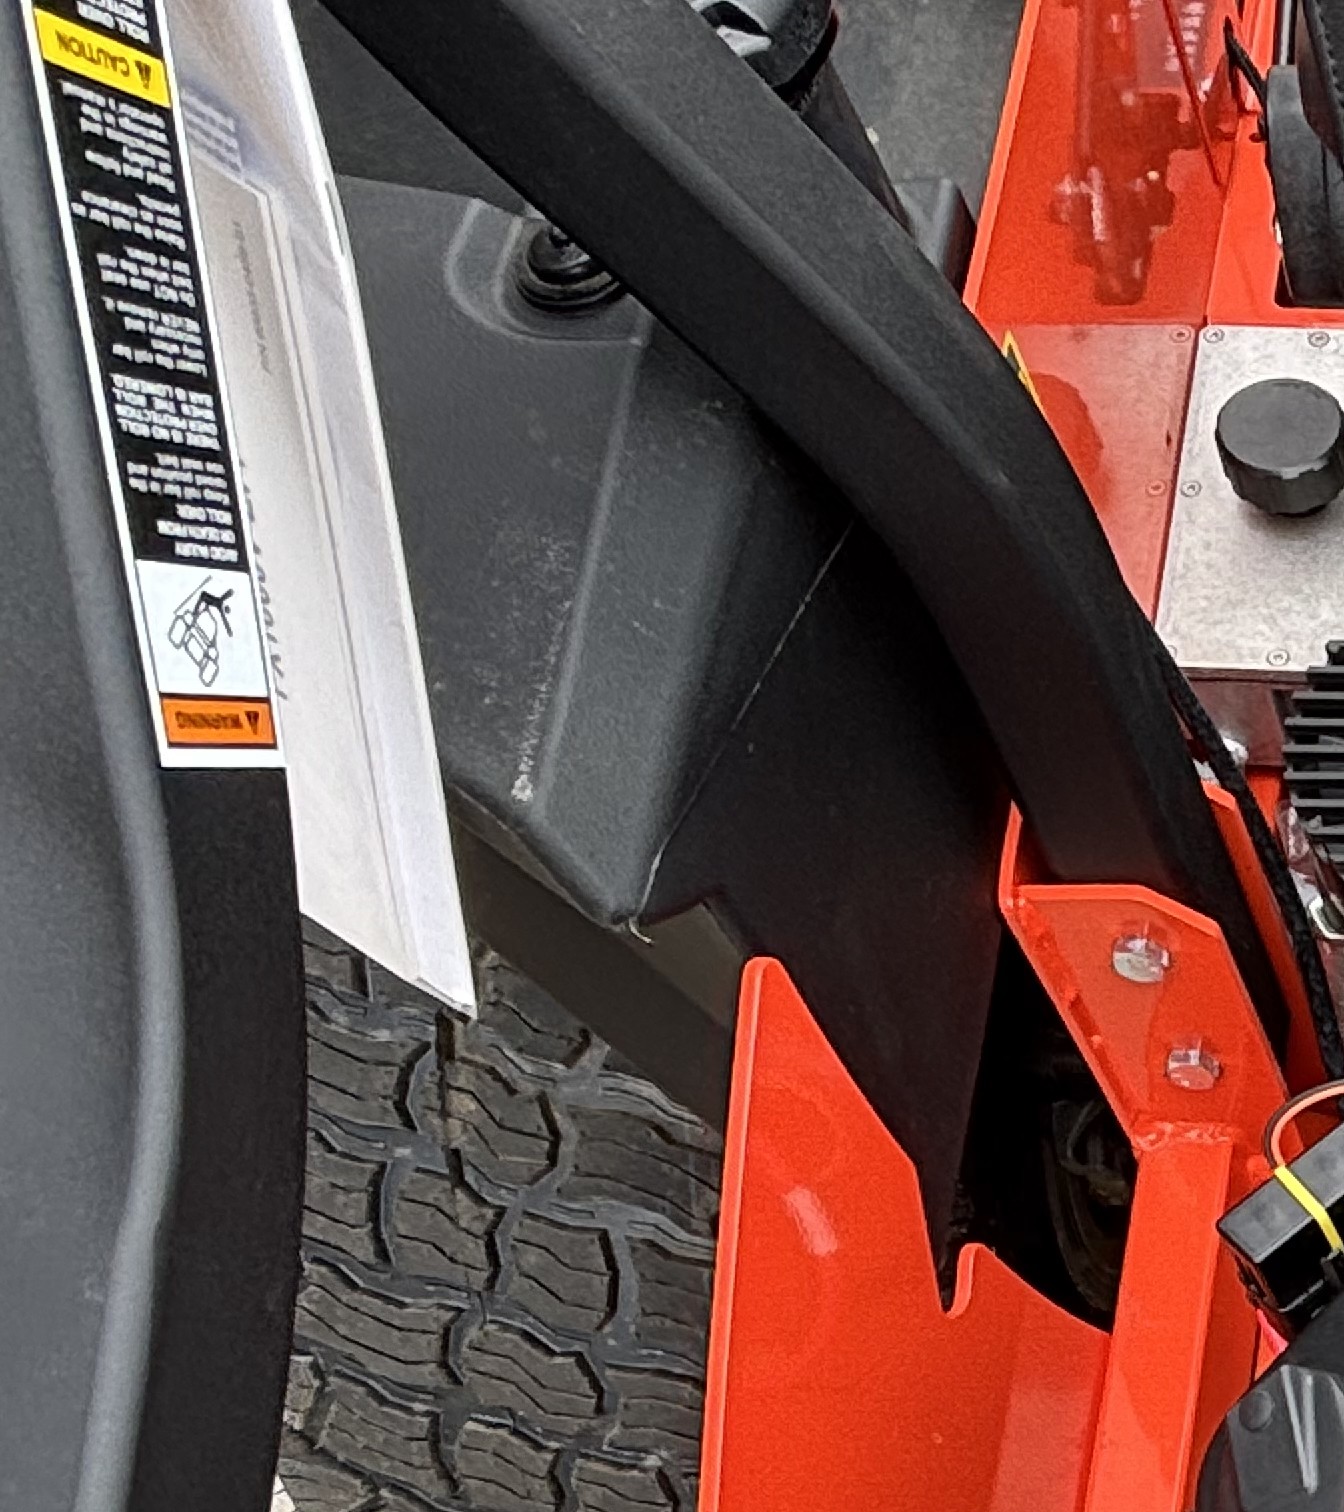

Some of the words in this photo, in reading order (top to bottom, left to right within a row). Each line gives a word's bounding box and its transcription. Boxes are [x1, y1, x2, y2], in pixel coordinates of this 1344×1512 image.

[54, 30, 130, 77] CAUTION
[112, 386, 147, 408] ROLL
[153, 397, 176, 414] THE
[117, 418, 150, 438] ROLL
[186, 432, 221, 450] THERE
